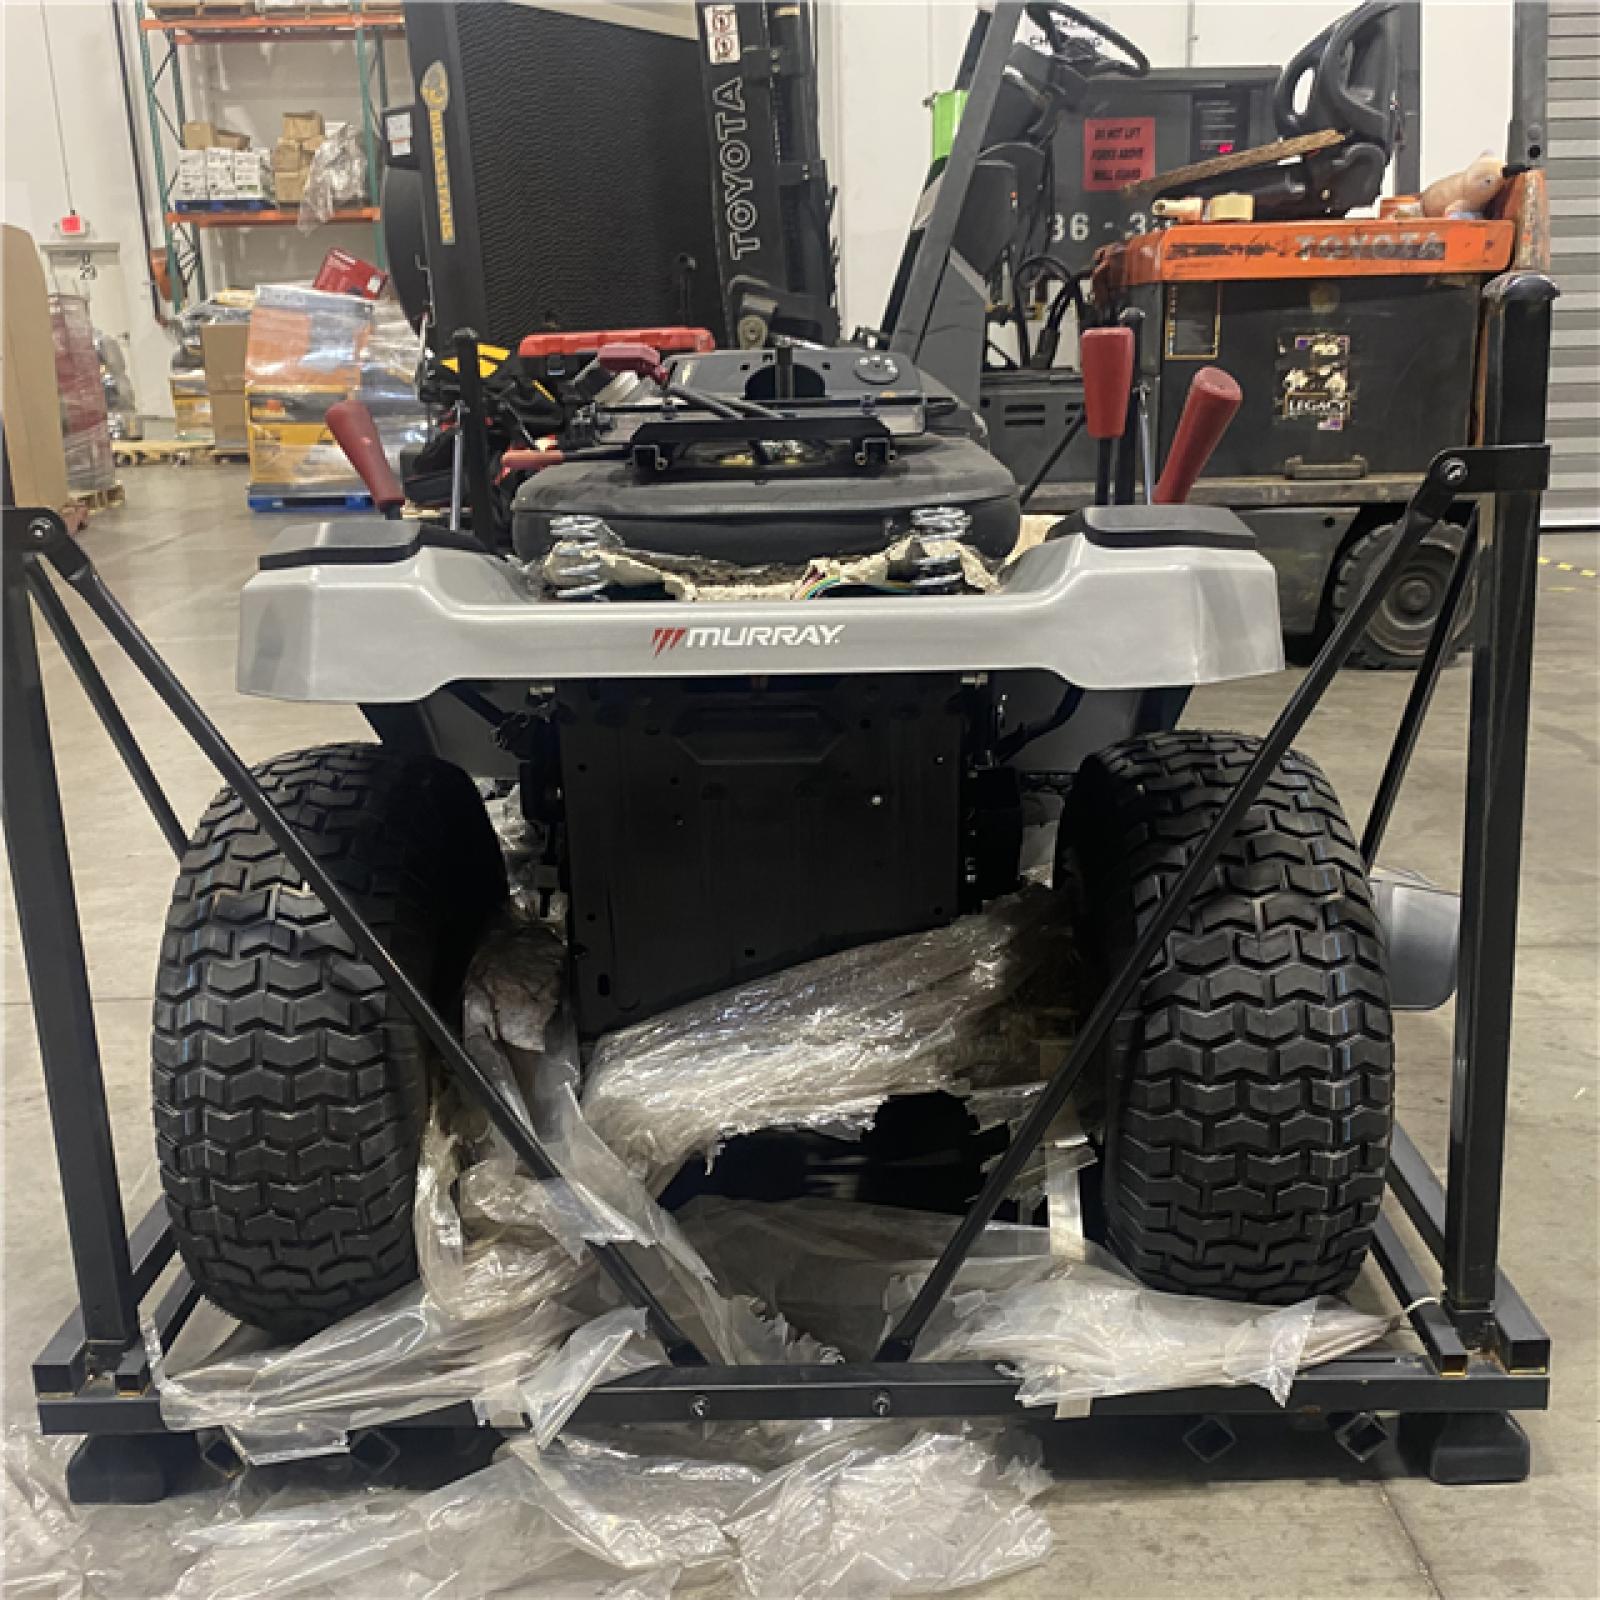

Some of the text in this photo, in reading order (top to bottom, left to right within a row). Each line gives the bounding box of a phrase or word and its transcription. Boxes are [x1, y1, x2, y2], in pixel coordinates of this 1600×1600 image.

[712, 76, 761, 261] TOYOTA
[1296, 231, 1444, 260] TOYOTA
[686, 624, 845, 648] MURRAY
